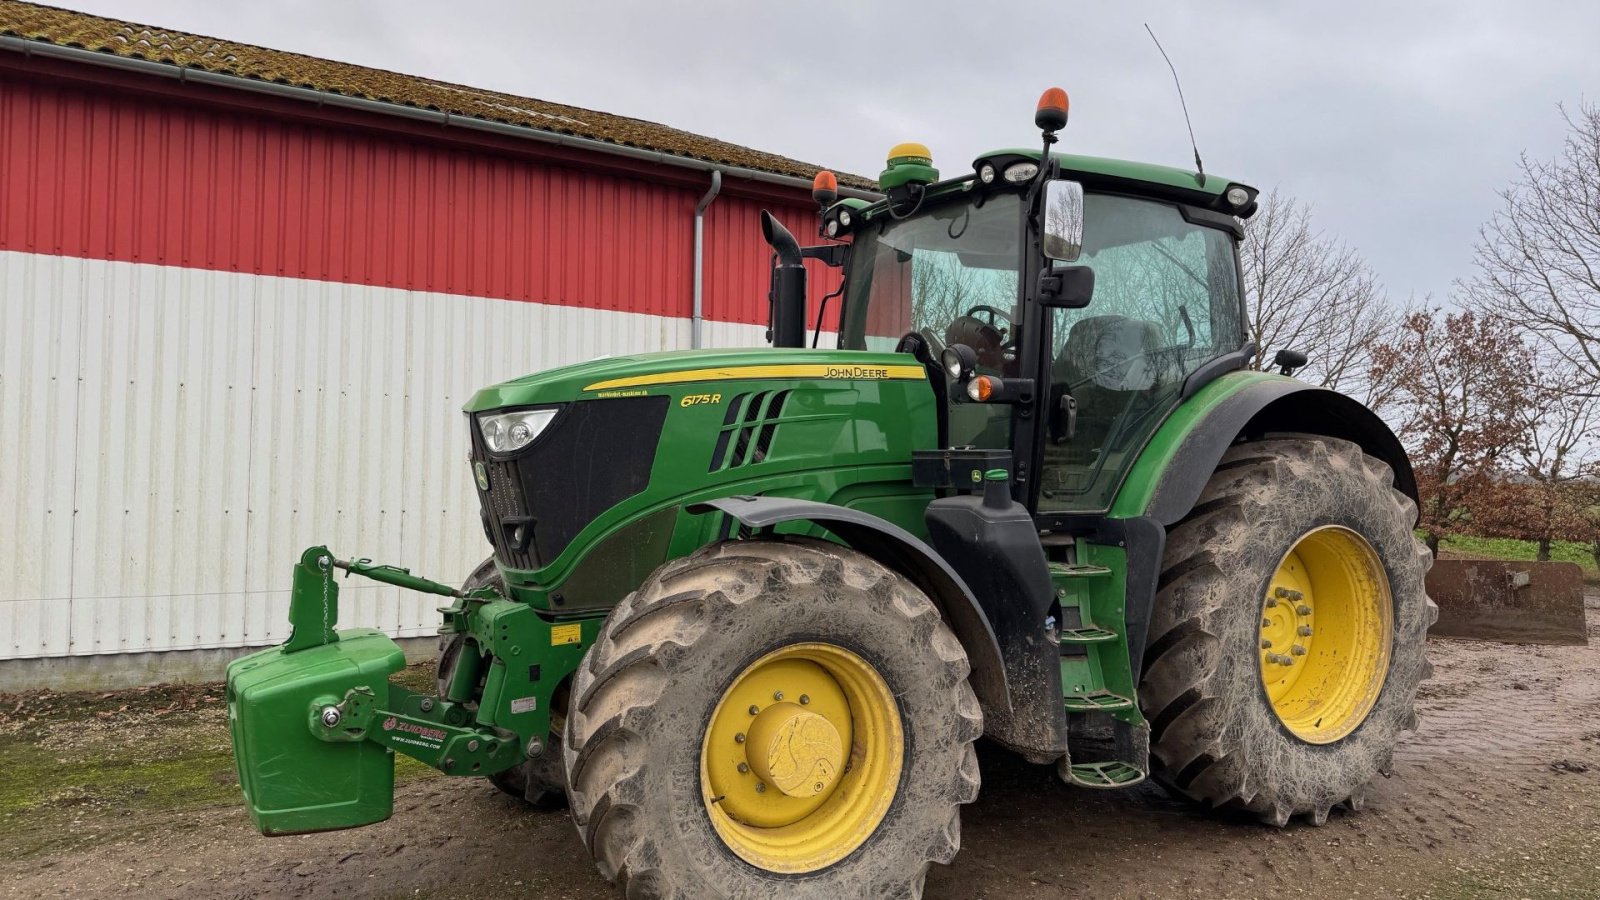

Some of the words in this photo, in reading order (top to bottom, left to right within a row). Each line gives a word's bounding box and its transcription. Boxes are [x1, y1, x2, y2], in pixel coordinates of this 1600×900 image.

[823, 366, 853, 377] JOHN
[854, 367, 889, 378] DEERE
[396, 722, 448, 740] ZUIDBERG
[391, 735, 441, 750] WWW.ZUIDBERG.COM
